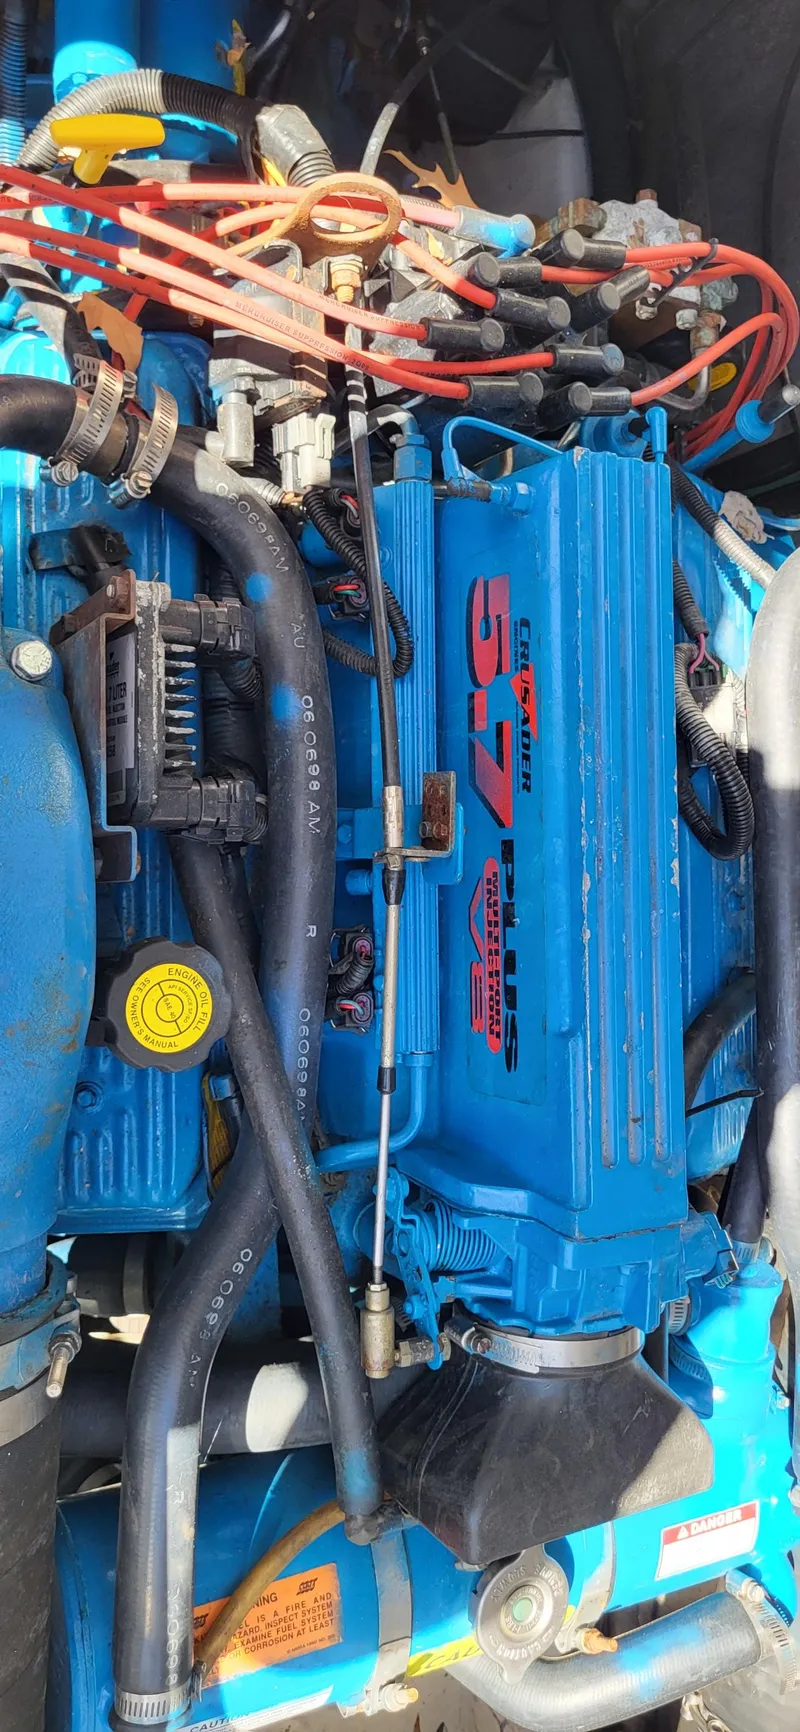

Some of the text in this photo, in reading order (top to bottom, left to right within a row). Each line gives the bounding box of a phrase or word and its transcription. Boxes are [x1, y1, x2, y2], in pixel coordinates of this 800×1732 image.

[234, 301, 291, 334] MERCRUISER
[292, 327, 349, 361] SUPPRESSION
[465, 573, 514, 829] 5.7
[519, 616, 532, 794] CRUSADER
[305, 923, 318, 938] R
[468, 875, 485, 1034] V8
[486, 878, 496, 1037] INJECTION
[500, 839, 519, 1074] PLUS
[130, 977, 179, 1049] SEE OWNER'S MANUAL
[163, 997, 173, 1011] SAE
[167, 967, 209, 1031] ENGINE OIL FILL
[178, 987, 194, 1007] SERVICE
[690, 1509, 742, 1535] DANGER
[491, 1564, 526, 1602] SLOWLY
[232, 1601, 333, 1640] AZARD. INSPECT SYSTEM
[256, 1613, 266, 1624] IS
[273, 1610, 279, 1618] A
[285, 1600, 307, 1614] FIRE
[313, 1592, 332, 1605] AND
[234, 1630, 275, 1650] EXAMINE
[276, 1622, 298, 1636] FUEL
[301, 1609, 334, 1627] SYSTEM
[244, 1632, 294, 1655] CORROSION
[296, 1627, 306, 1638] AT
[308, 1617, 334, 1633] LEAST
